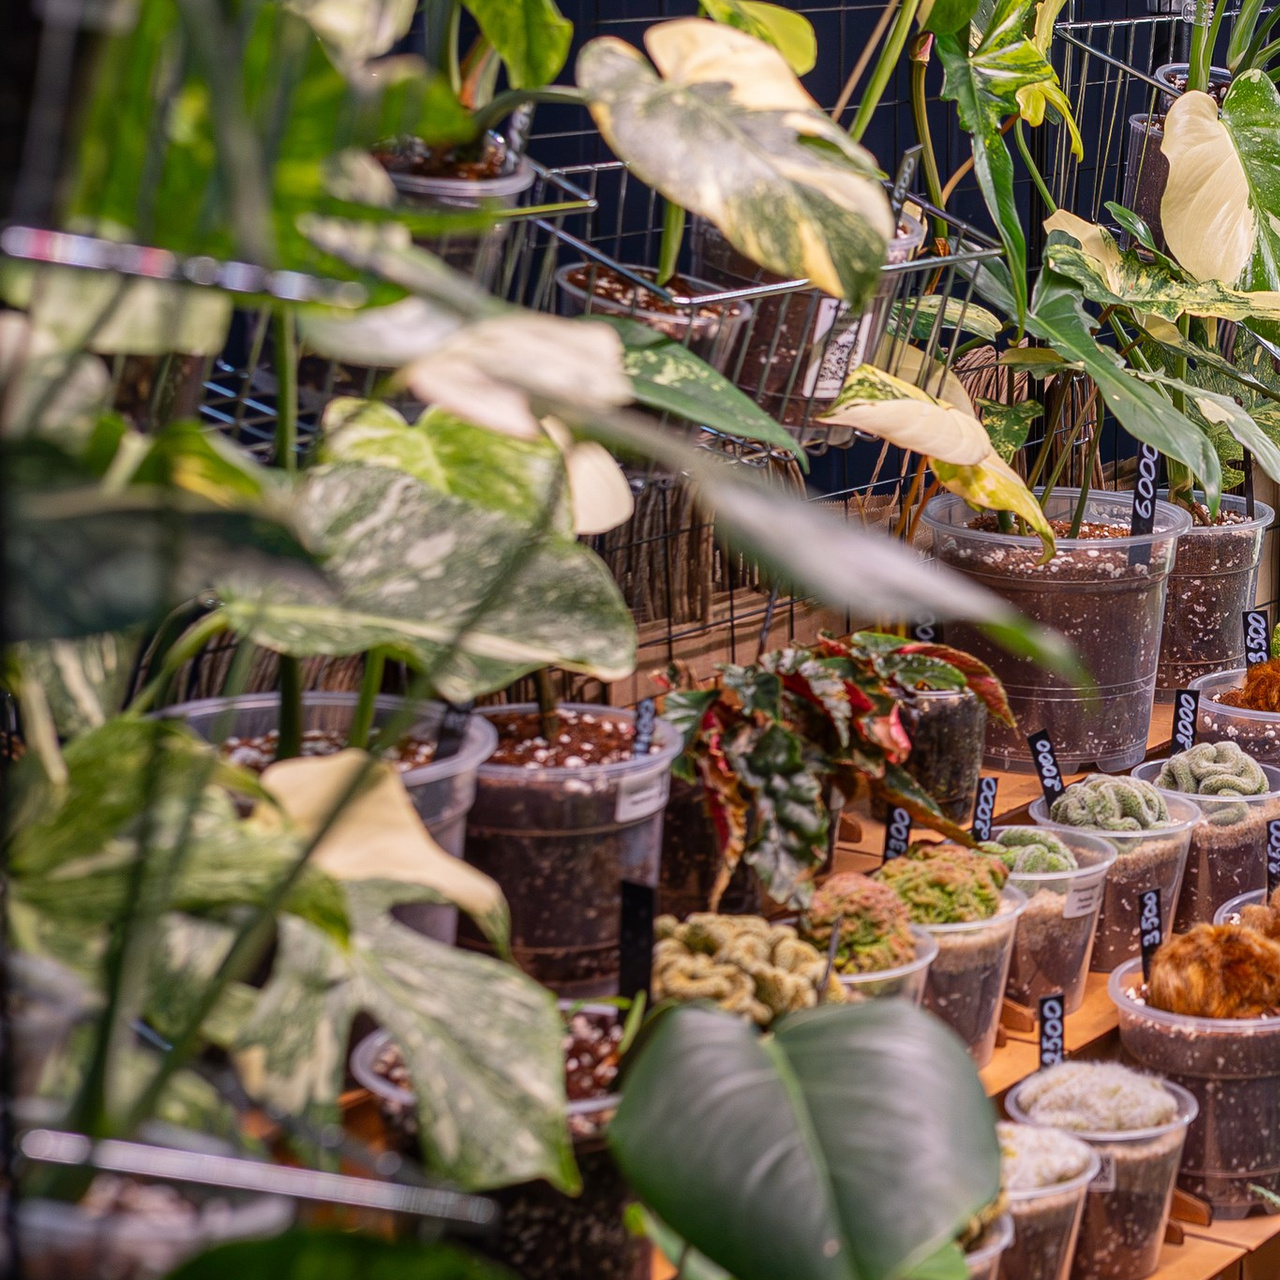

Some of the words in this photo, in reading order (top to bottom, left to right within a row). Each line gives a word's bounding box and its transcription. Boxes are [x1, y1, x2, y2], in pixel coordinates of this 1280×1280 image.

[1247, 612, 1268, 663] 3500
[1036, 739, 1062, 792] 2000
[974, 777, 996, 840] 2000
[1140, 892, 1160, 946] 3500
[1042, 999, 1063, 1066] 2500
